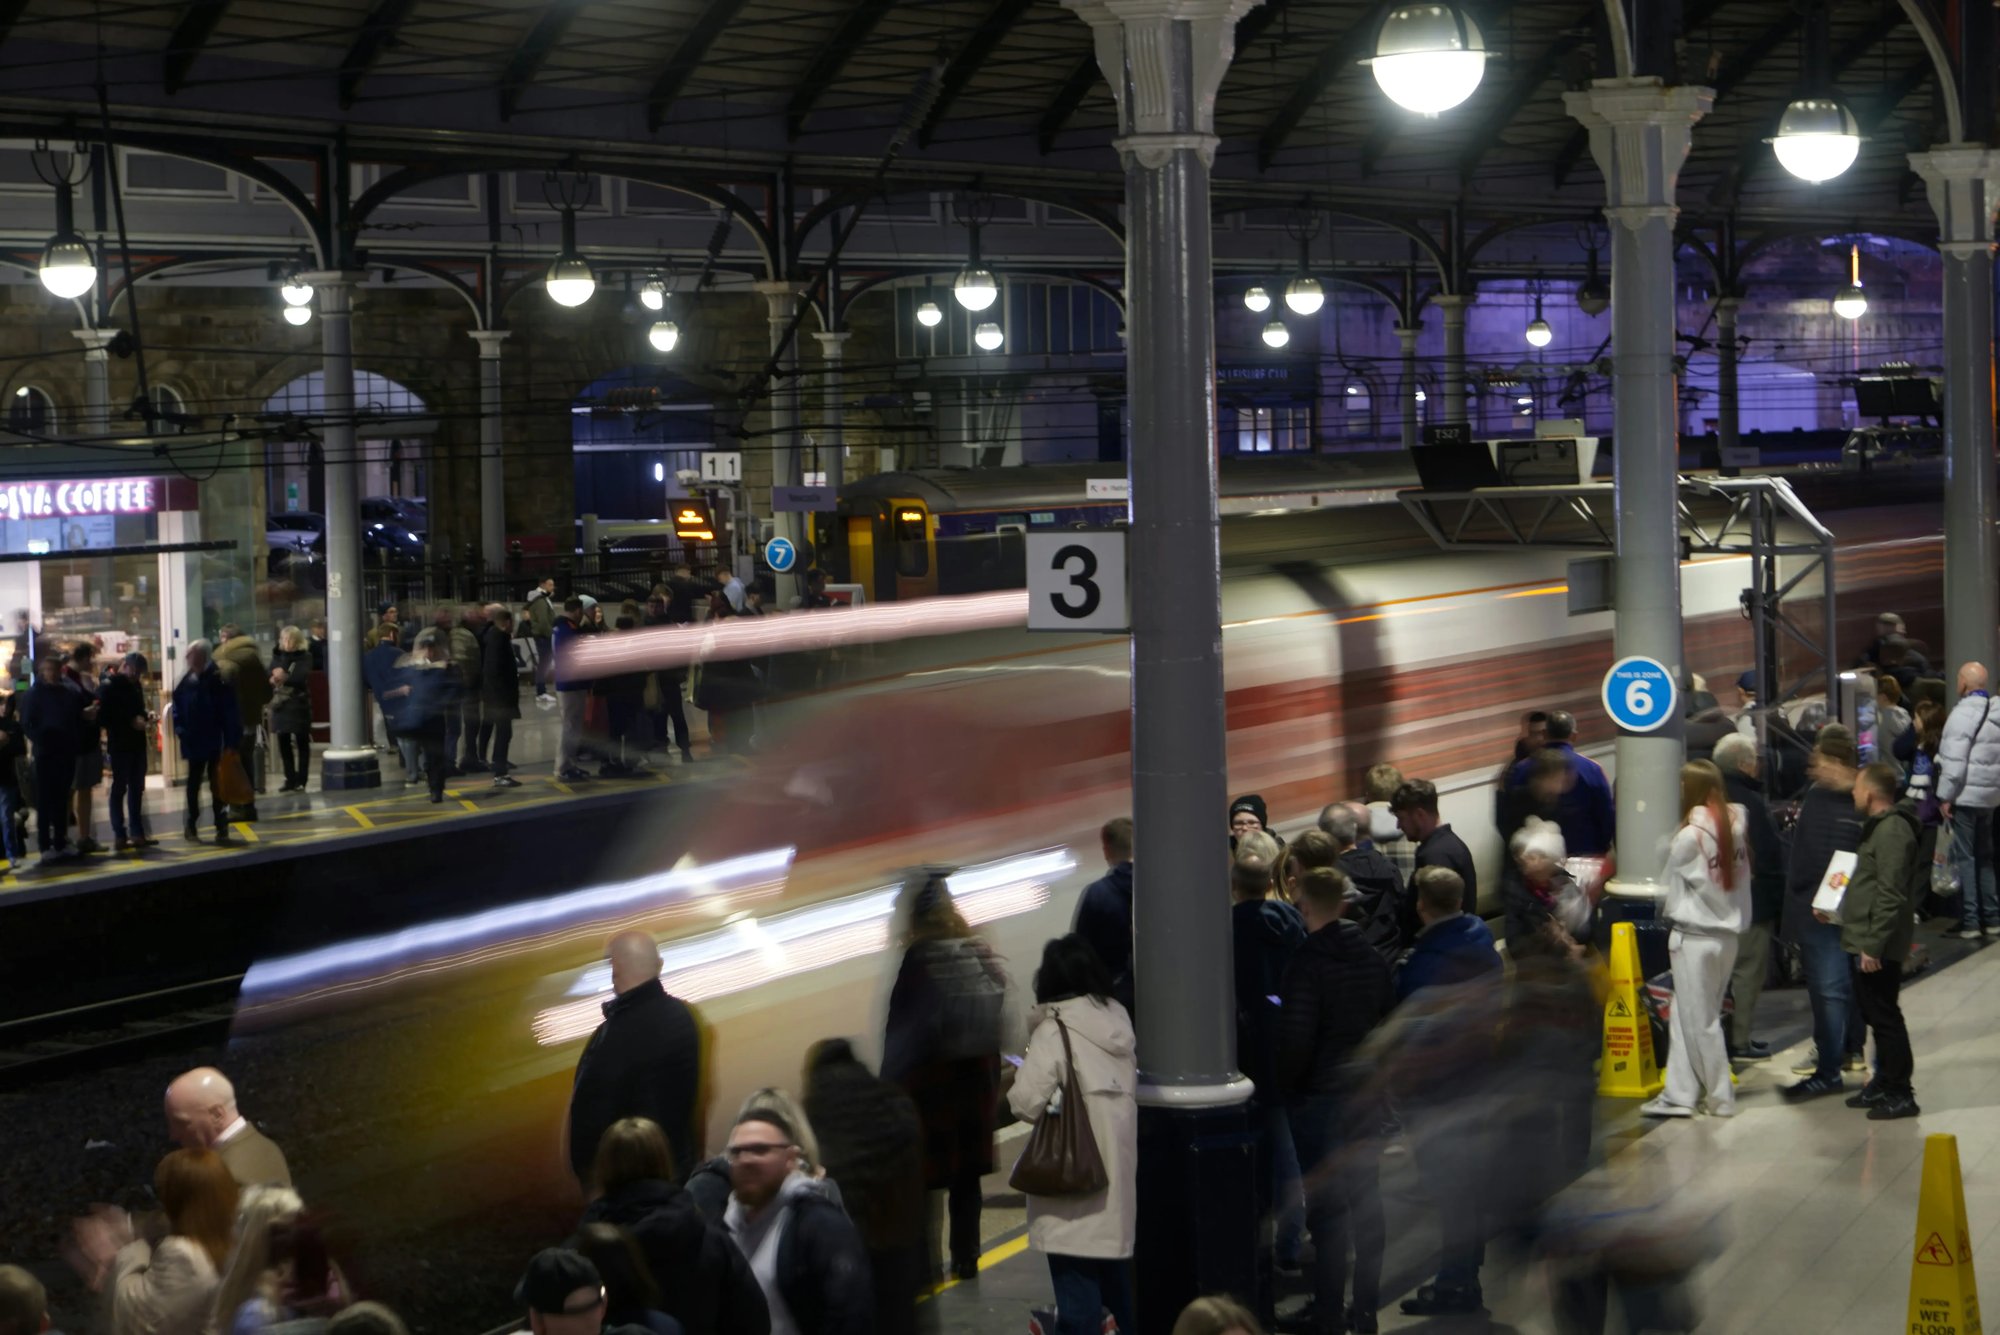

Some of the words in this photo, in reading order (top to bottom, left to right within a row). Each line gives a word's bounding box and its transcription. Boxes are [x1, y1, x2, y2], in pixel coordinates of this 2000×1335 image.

[56, 481, 155, 514] COFFEE
[775, 547, 786, 564] 7
[1049, 544, 1101, 619] 3
[1626, 679, 1653, 715] 6
[1919, 1311, 1949, 1322] WET
[1912, 1324, 1955, 1335] FLOOR
